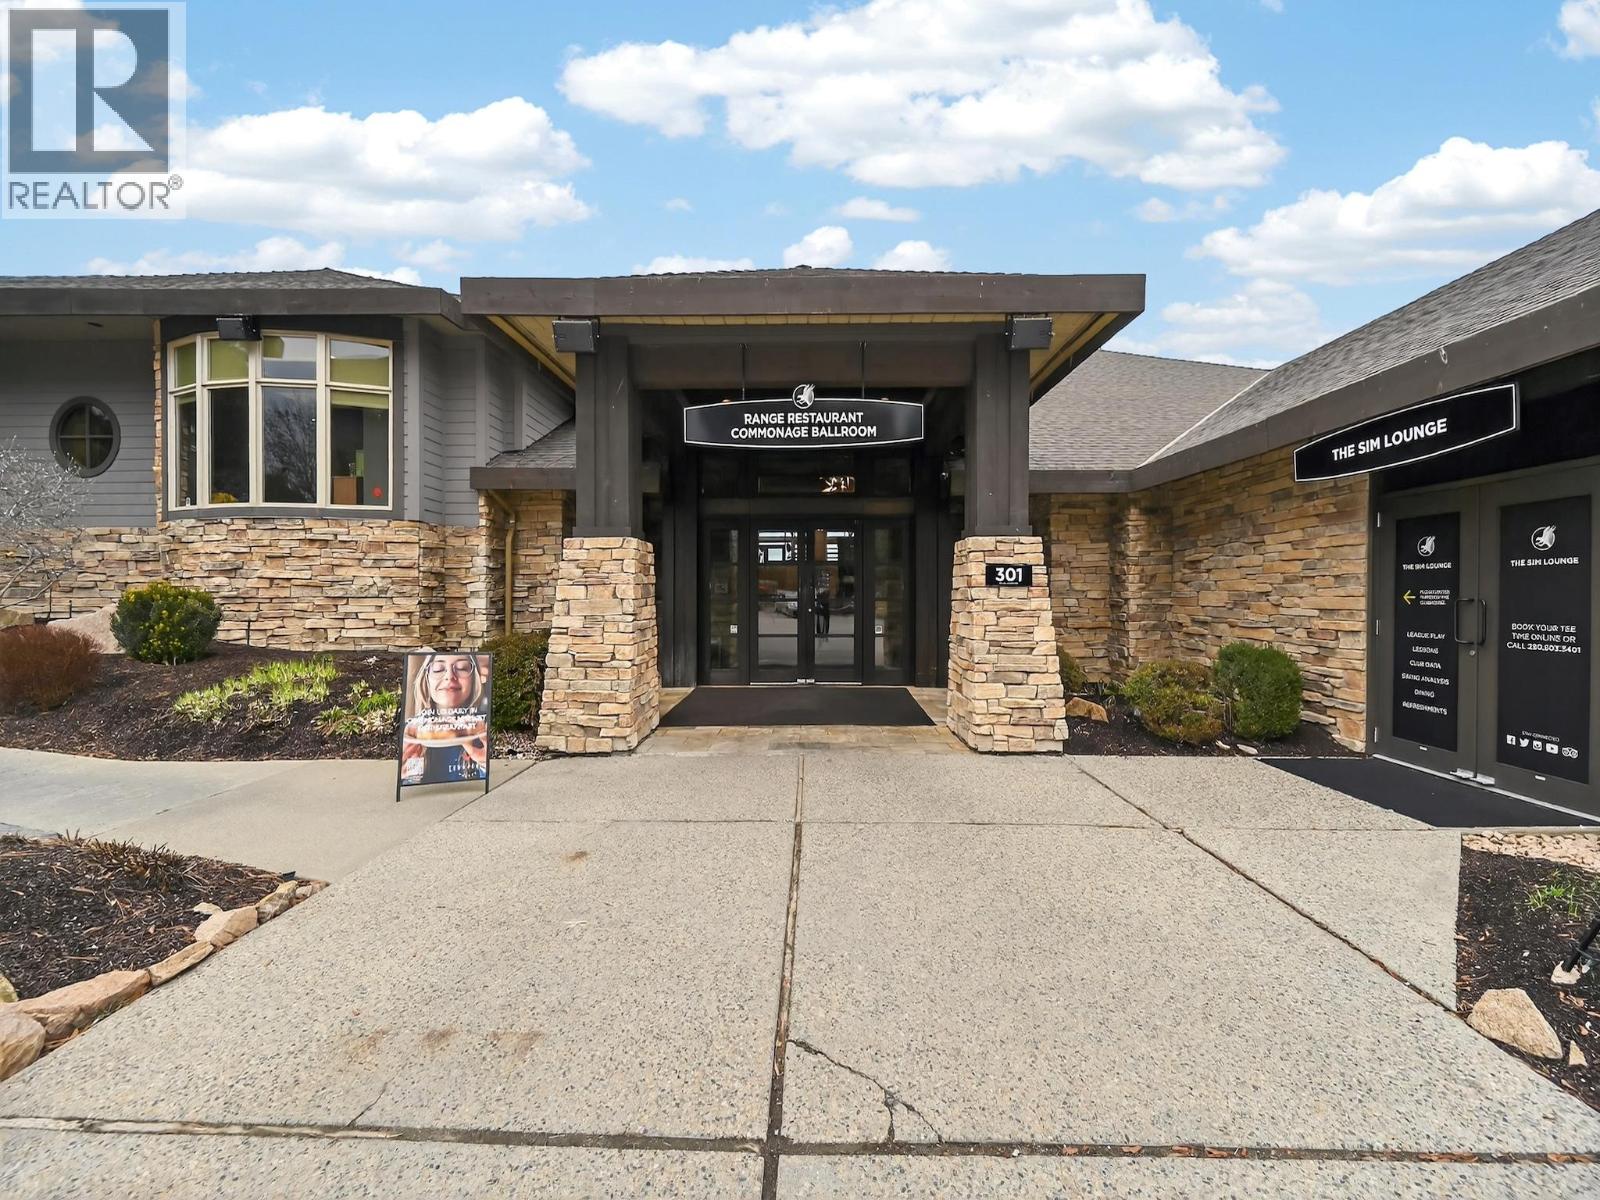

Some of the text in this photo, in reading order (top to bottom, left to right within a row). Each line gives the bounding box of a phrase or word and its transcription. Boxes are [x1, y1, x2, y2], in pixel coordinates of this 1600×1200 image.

[744, 412, 864, 425] RANGE RESTAURANT
[731, 425, 877, 439] COMMONAGE BALLROOM
[1332, 418, 1448, 461] THE SIM LOUNGE
[1510, 557, 1580, 567] THE SIM LOUNGE
[995, 567, 1023, 582] 301
[1511, 623, 1577, 633] BOOK YOUR TEE
[1512, 632, 1577, 643] TIME ONLINE OR
[1506, 641, 1526, 650] CALL
